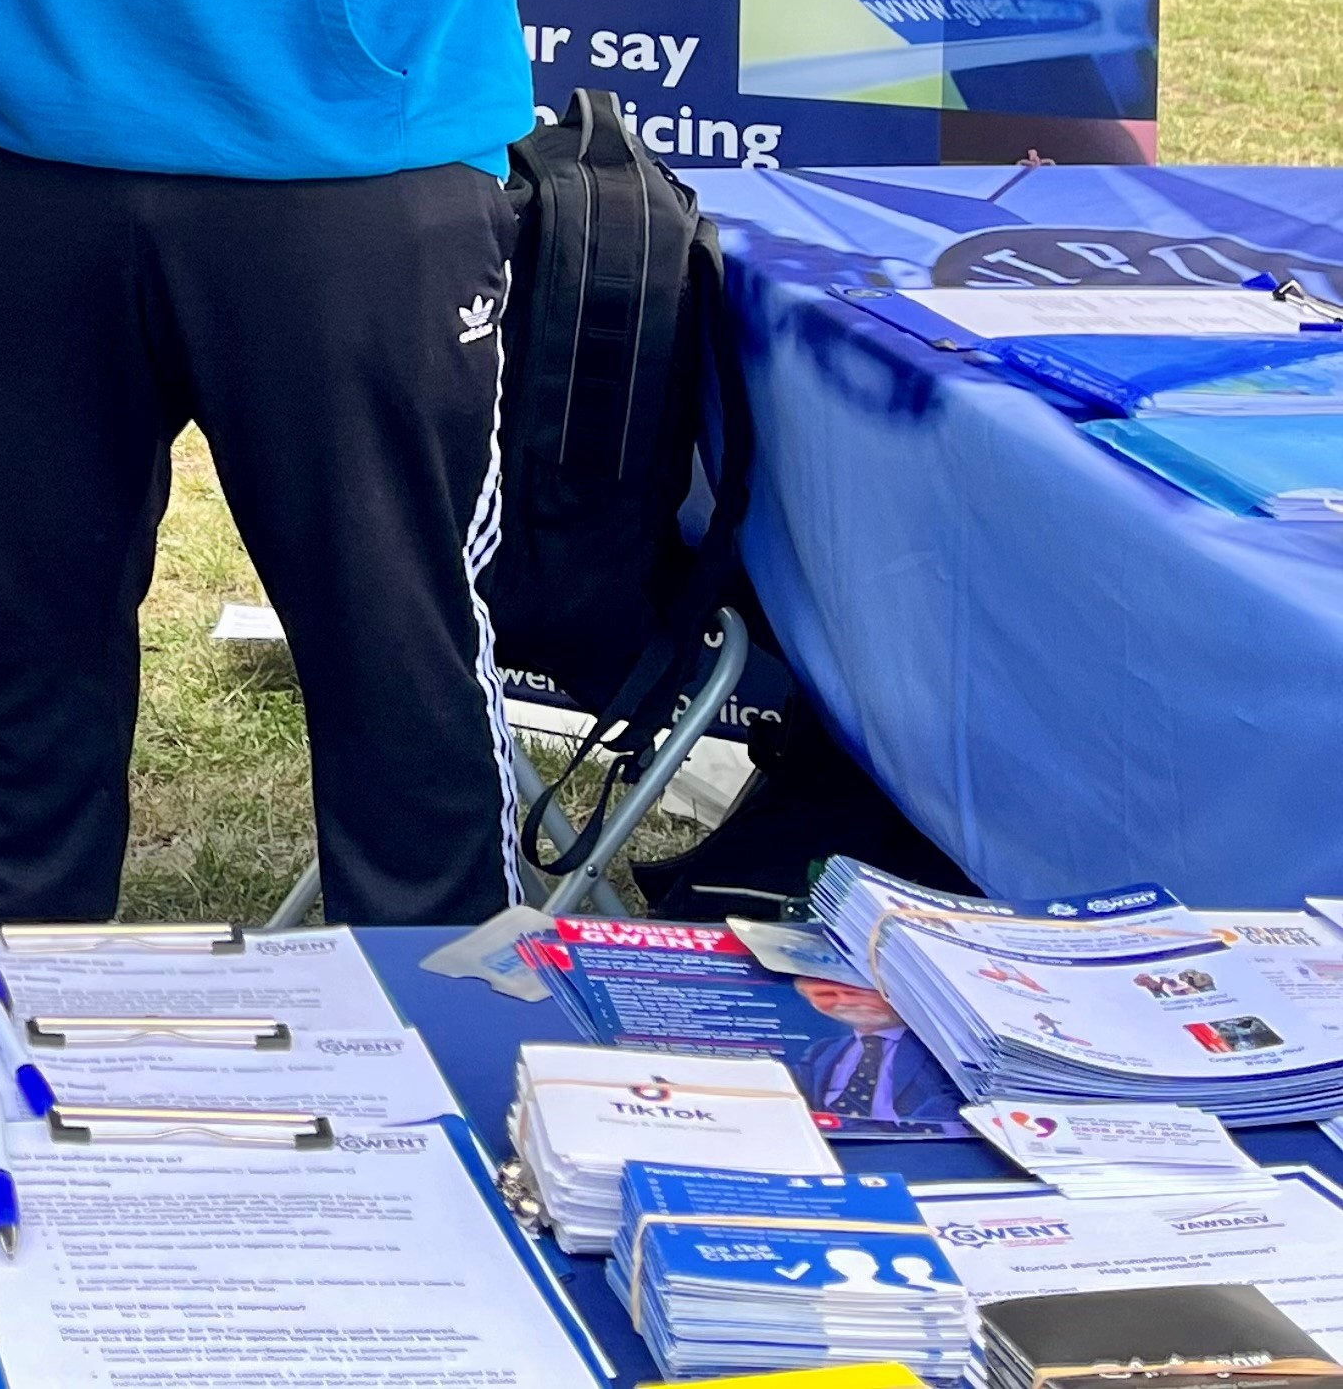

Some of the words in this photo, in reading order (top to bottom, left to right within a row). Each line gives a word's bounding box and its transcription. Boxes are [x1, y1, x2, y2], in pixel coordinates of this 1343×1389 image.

[590, 30, 699, 88] say
[568, 919, 614, 932] THE
[617, 923, 690, 939] VOICE
[694, 929, 725, 941] OF
[580, 930, 720, 951] GWENT
[609, 1101, 717, 1122] TikTok
[951, 1220, 1073, 1244] GWENT
